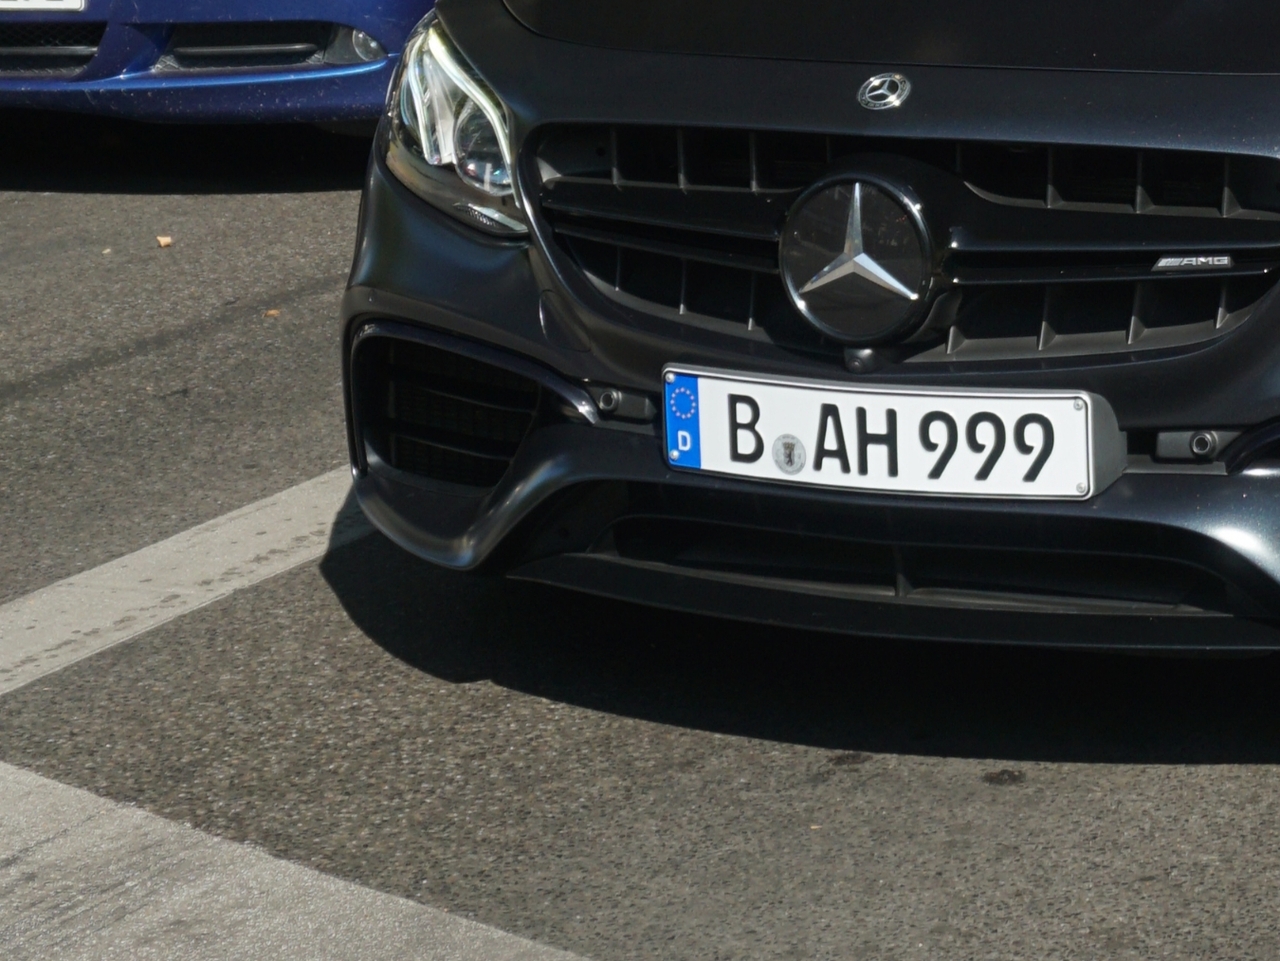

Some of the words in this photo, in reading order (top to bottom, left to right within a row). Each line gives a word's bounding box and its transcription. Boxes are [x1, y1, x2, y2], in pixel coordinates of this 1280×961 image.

[1180, 256, 1228, 266] AMG
[676, 430, 692, 451] D
[727, 393, 765, 463] B
[813, 403, 899, 477] AH
[918, 410, 1055, 482] 999
